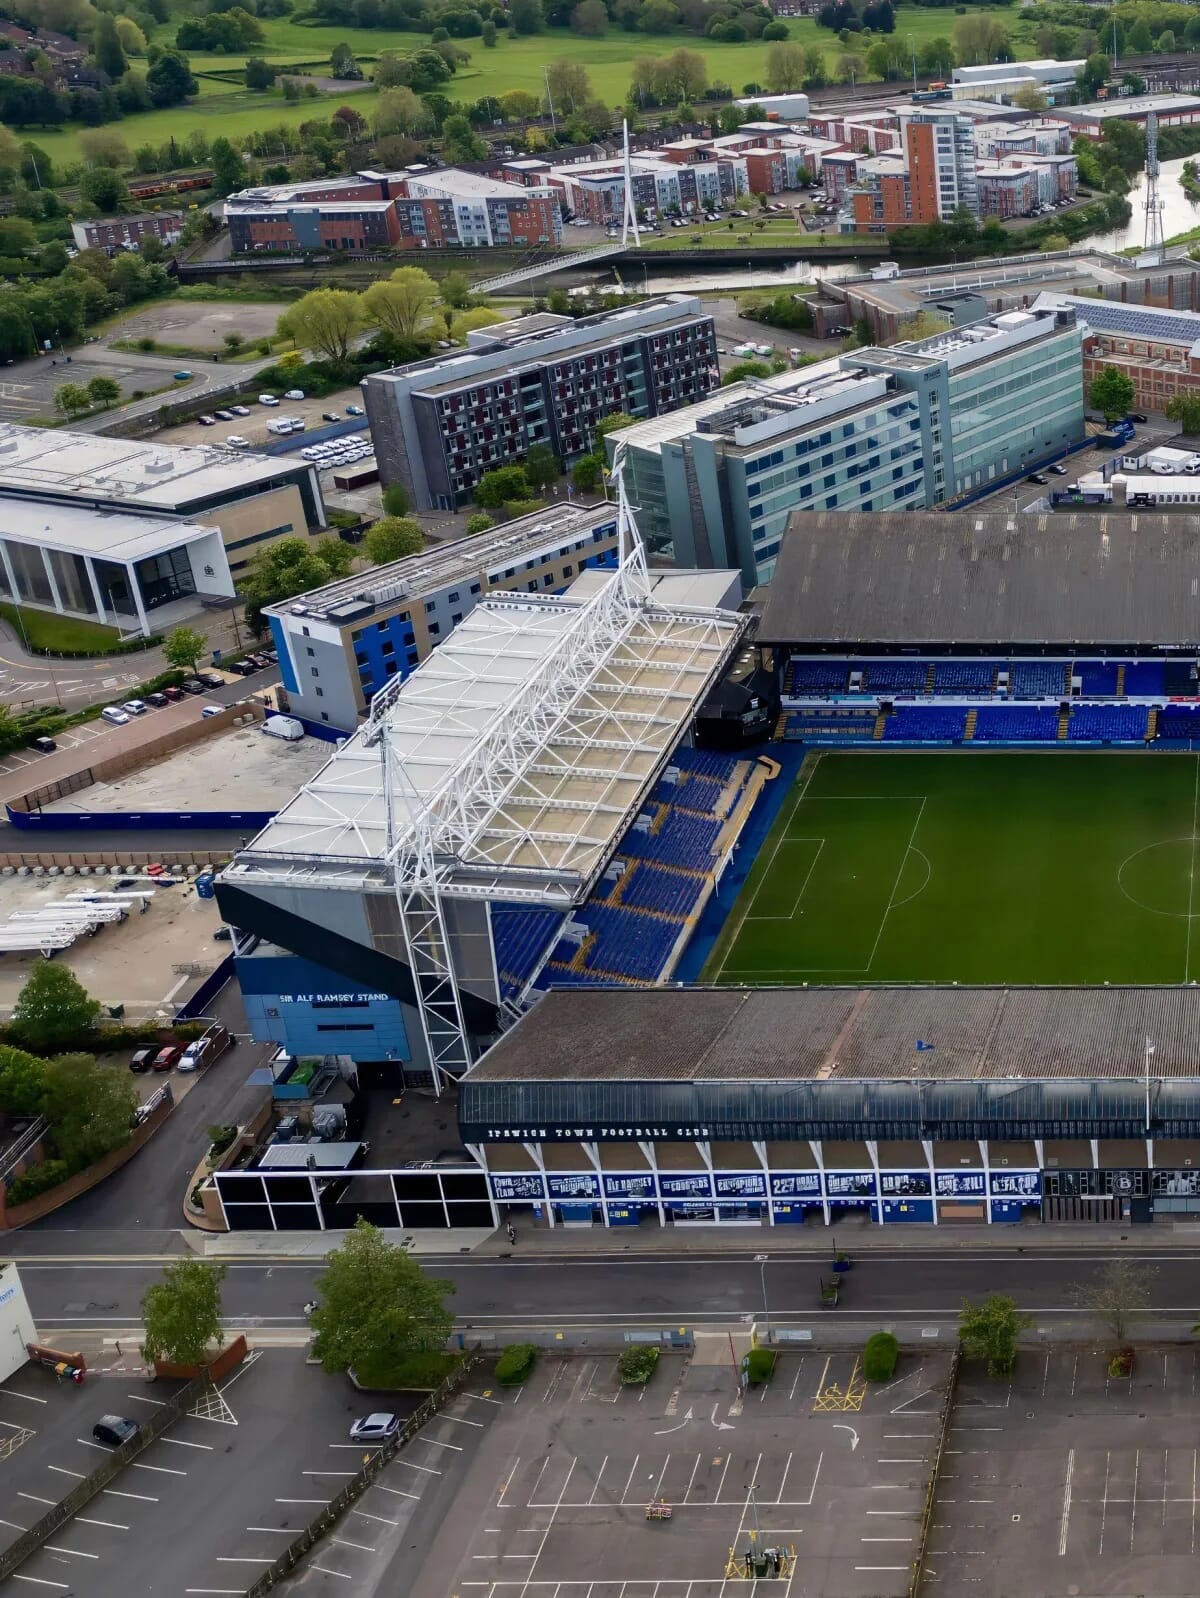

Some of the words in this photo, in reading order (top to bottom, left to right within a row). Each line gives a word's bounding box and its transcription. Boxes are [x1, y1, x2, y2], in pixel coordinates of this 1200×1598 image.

[279, 994, 294, 1003] SIR
[297, 993, 314, 1003] ALF
[316, 993, 355, 1003] RAMSEY
[357, 992, 389, 1002] STAND
[487, 1129, 547, 1138] IPSWICH
[555, 1129, 594, 1137] TOWN
[601, 1127, 668, 1137] FOOTBALL
[676, 1127, 710, 1136] CLUB
